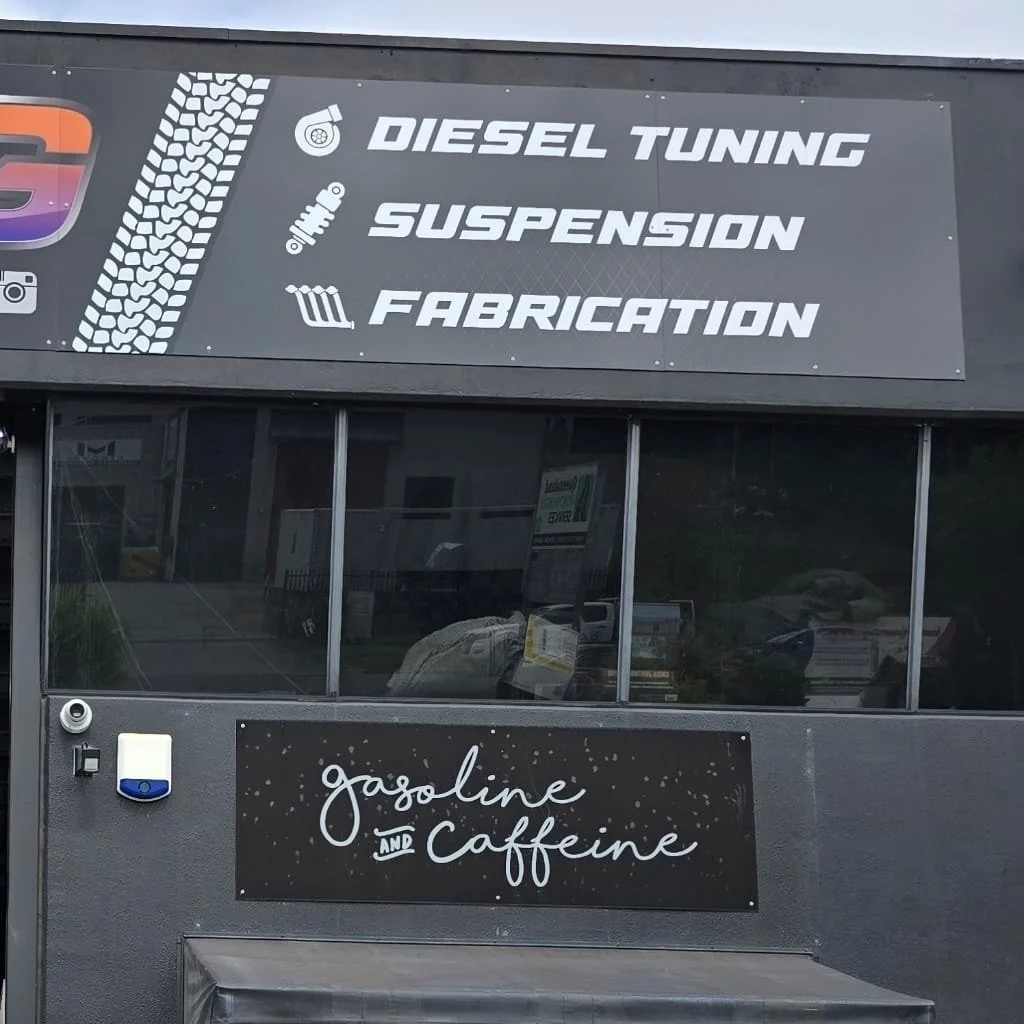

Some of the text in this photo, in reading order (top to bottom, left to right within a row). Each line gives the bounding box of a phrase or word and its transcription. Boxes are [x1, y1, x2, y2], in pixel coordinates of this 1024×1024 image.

[366, 116, 871, 168] DIESEL TUNING
[367, 202, 806, 251] SUSPENSION
[367, 289, 821, 338] FABRICATION
[319, 745, 587, 847] gasoline
[379, 833, 412, 855] AND
